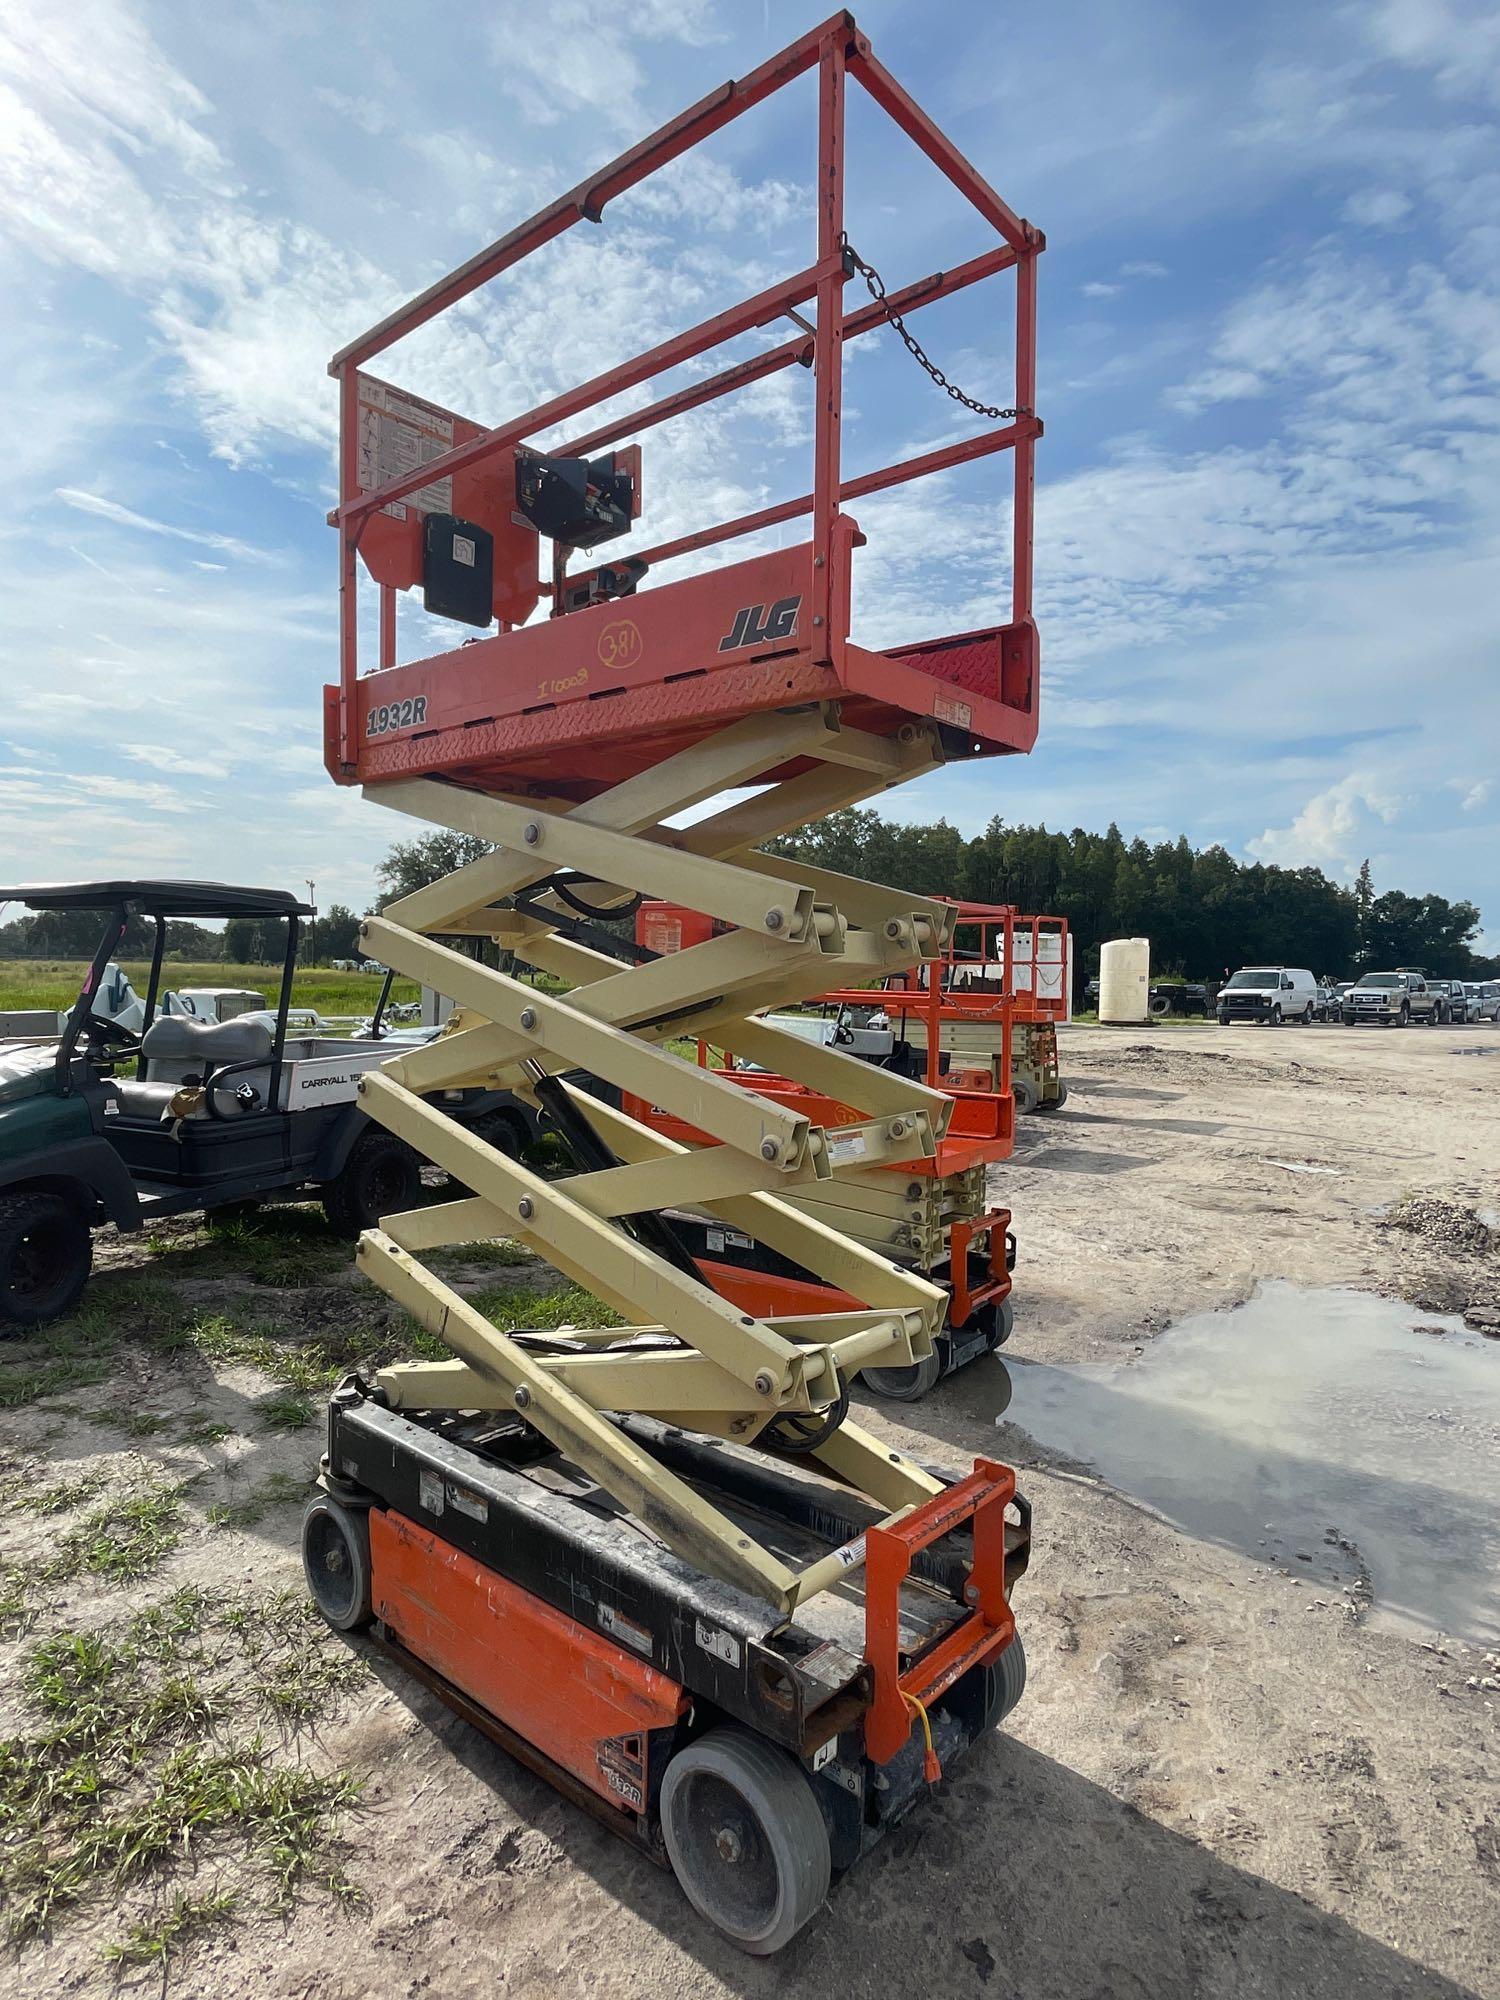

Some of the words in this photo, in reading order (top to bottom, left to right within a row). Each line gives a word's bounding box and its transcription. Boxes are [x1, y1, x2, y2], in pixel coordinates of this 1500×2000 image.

[717, 592, 803, 649] JLG
[602, 628, 635, 664] 381
[366, 695, 427, 738] 1932R
[301, 1075, 347, 1089] CARRYALL
